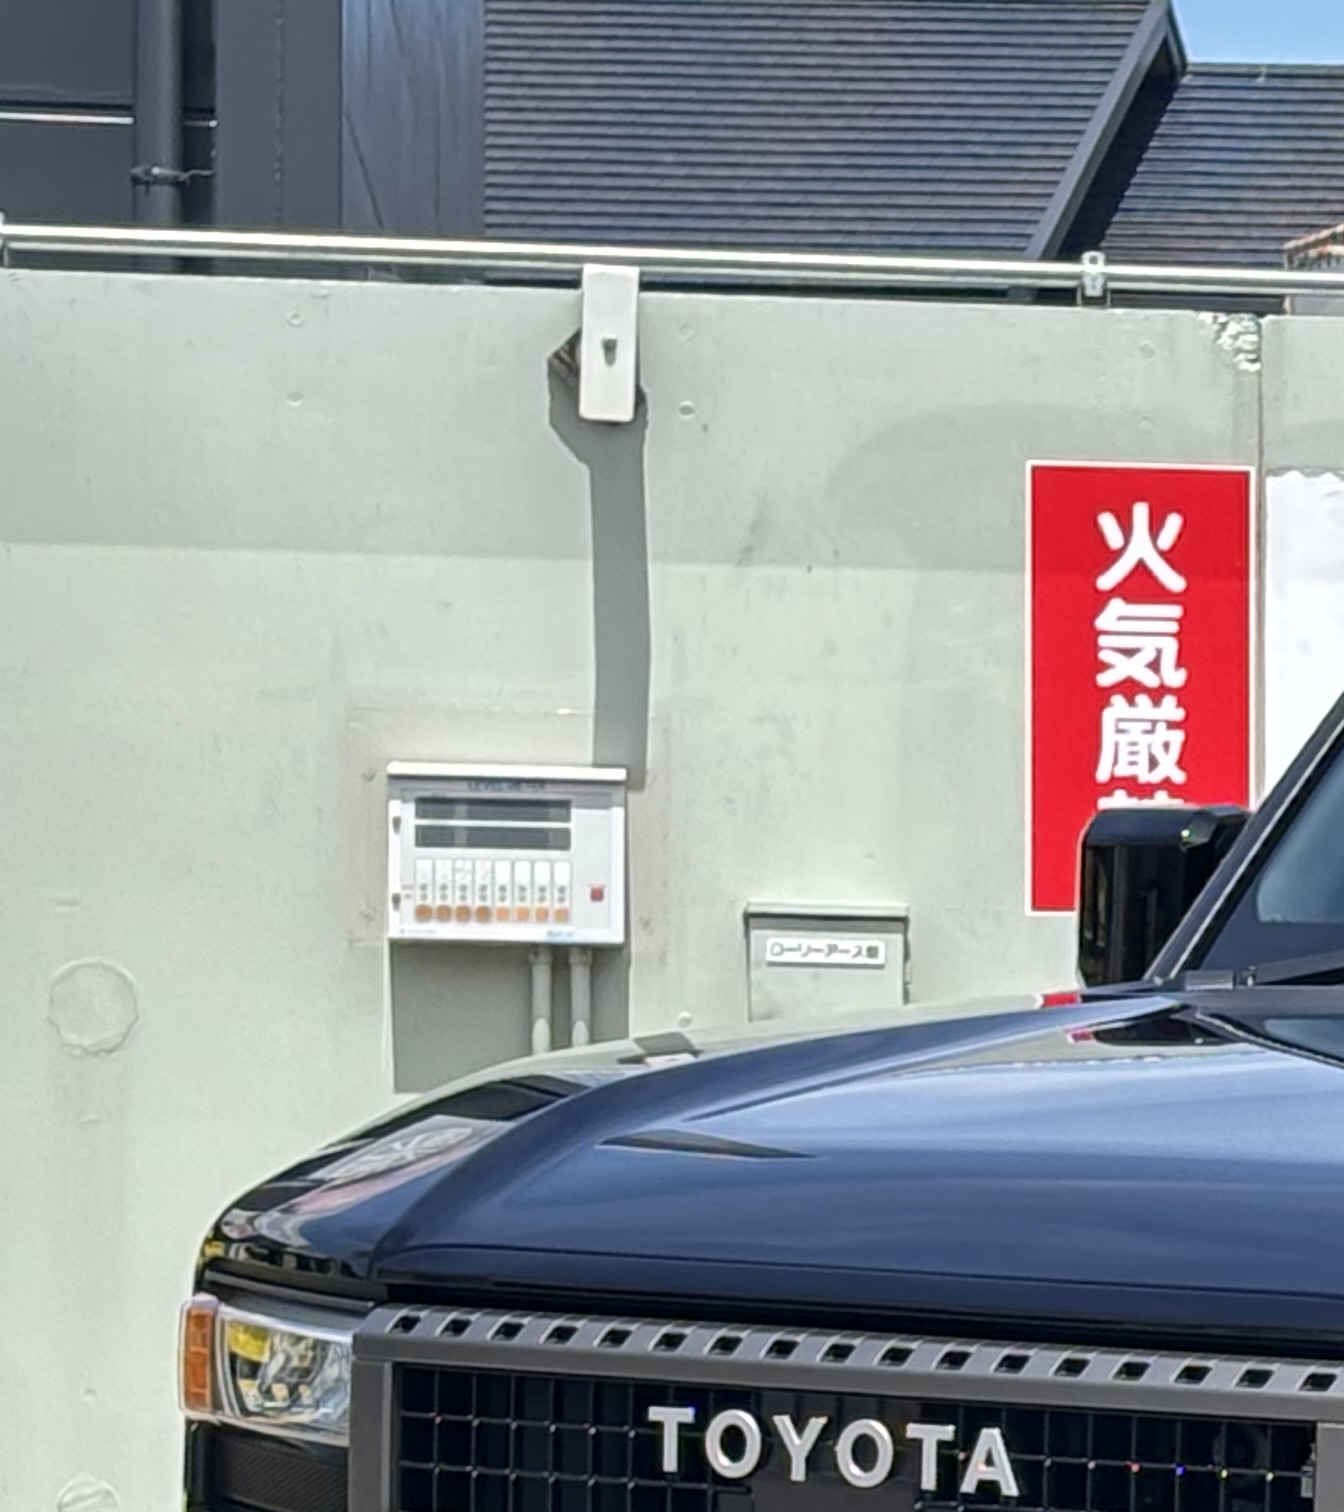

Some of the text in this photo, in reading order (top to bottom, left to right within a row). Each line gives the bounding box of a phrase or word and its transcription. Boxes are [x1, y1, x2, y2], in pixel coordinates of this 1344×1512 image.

[1094, 501, 1188, 810] 火気厳
[647, 1405, 1020, 1498] TOYOTA
